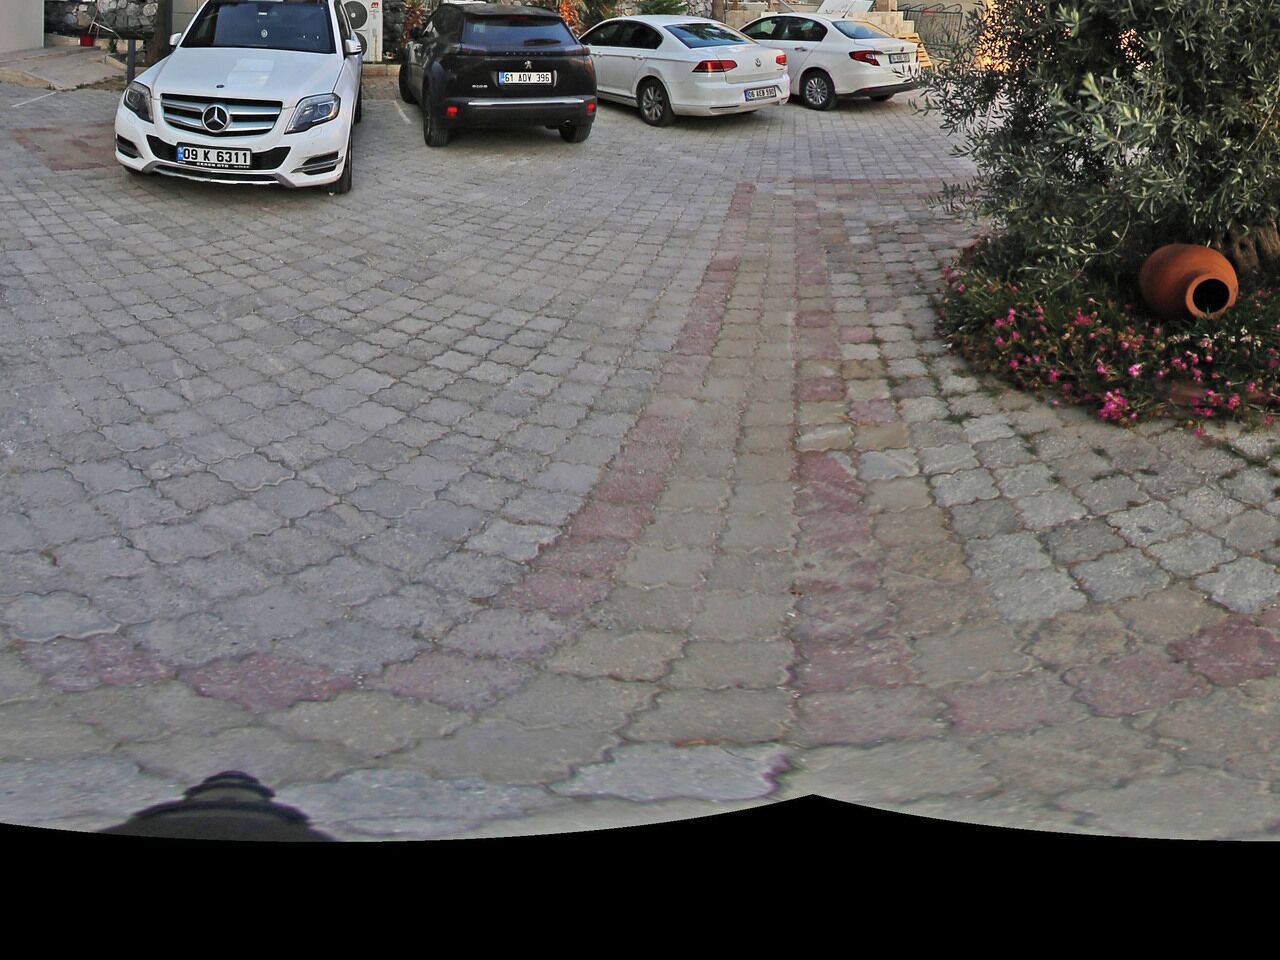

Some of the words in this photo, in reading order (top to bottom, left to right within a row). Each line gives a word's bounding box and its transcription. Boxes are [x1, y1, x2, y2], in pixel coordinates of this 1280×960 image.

[505, 74, 513, 82] 61
[519, 74, 532, 82] ADV
[537, 74, 550, 82] 396
[184, 148, 198, 160] 09
[203, 150, 211, 161] K
[216, 151, 247, 164] 6311
